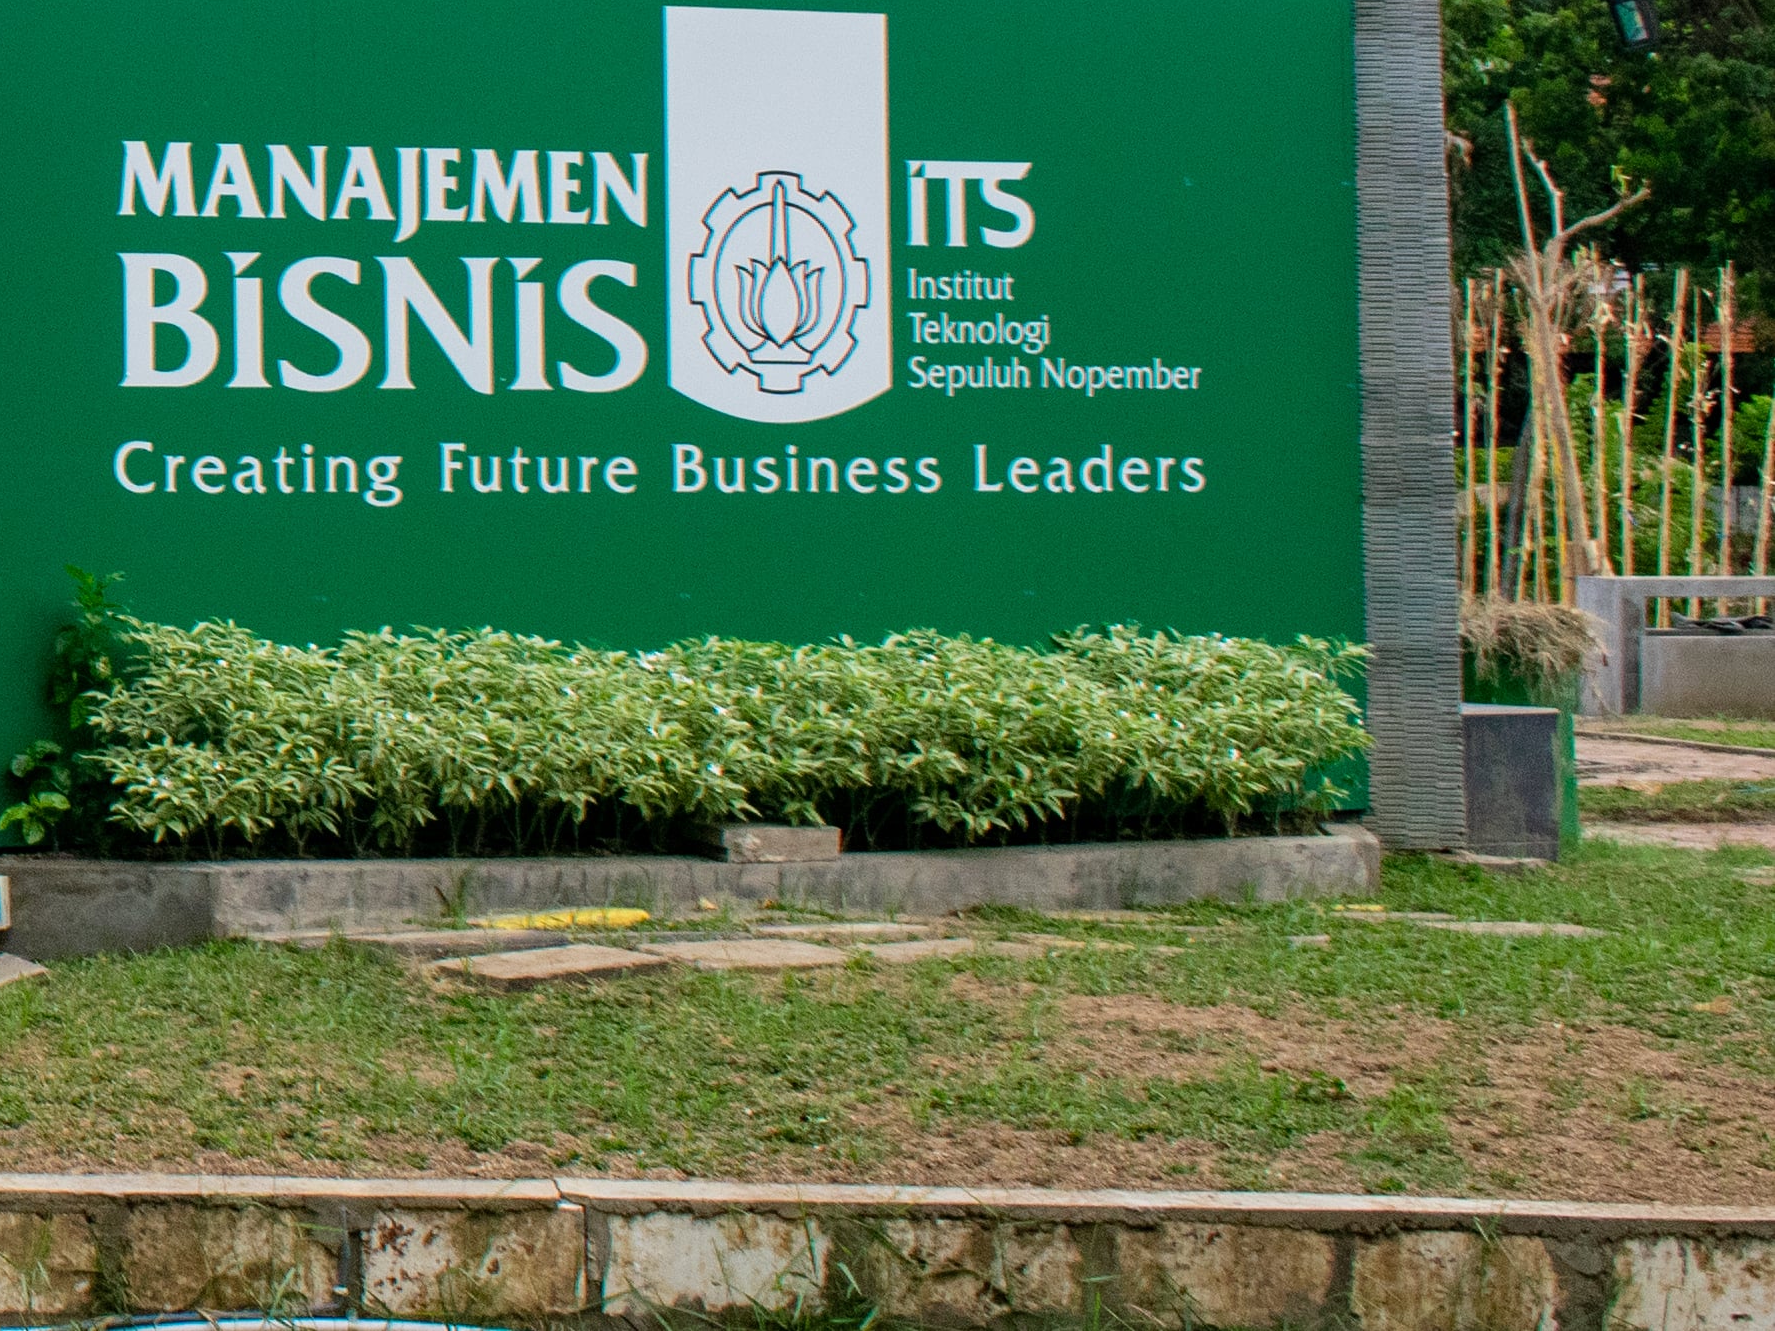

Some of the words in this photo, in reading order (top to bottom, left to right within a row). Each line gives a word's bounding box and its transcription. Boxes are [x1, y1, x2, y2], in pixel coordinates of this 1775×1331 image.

[118, 140, 649, 243] MANAJEMEN
[908, 267, 1016, 301] Institut
[908, 311, 1052, 355] Teknologi
[909, 355, 1033, 398] Sepuluh
[1042, 356, 1204, 399] Nopember
[115, 440, 404, 508] Creating
[442, 442, 639, 494] Future
[675, 443, 943, 494] Business
[975, 444, 1208, 494] Leaders
